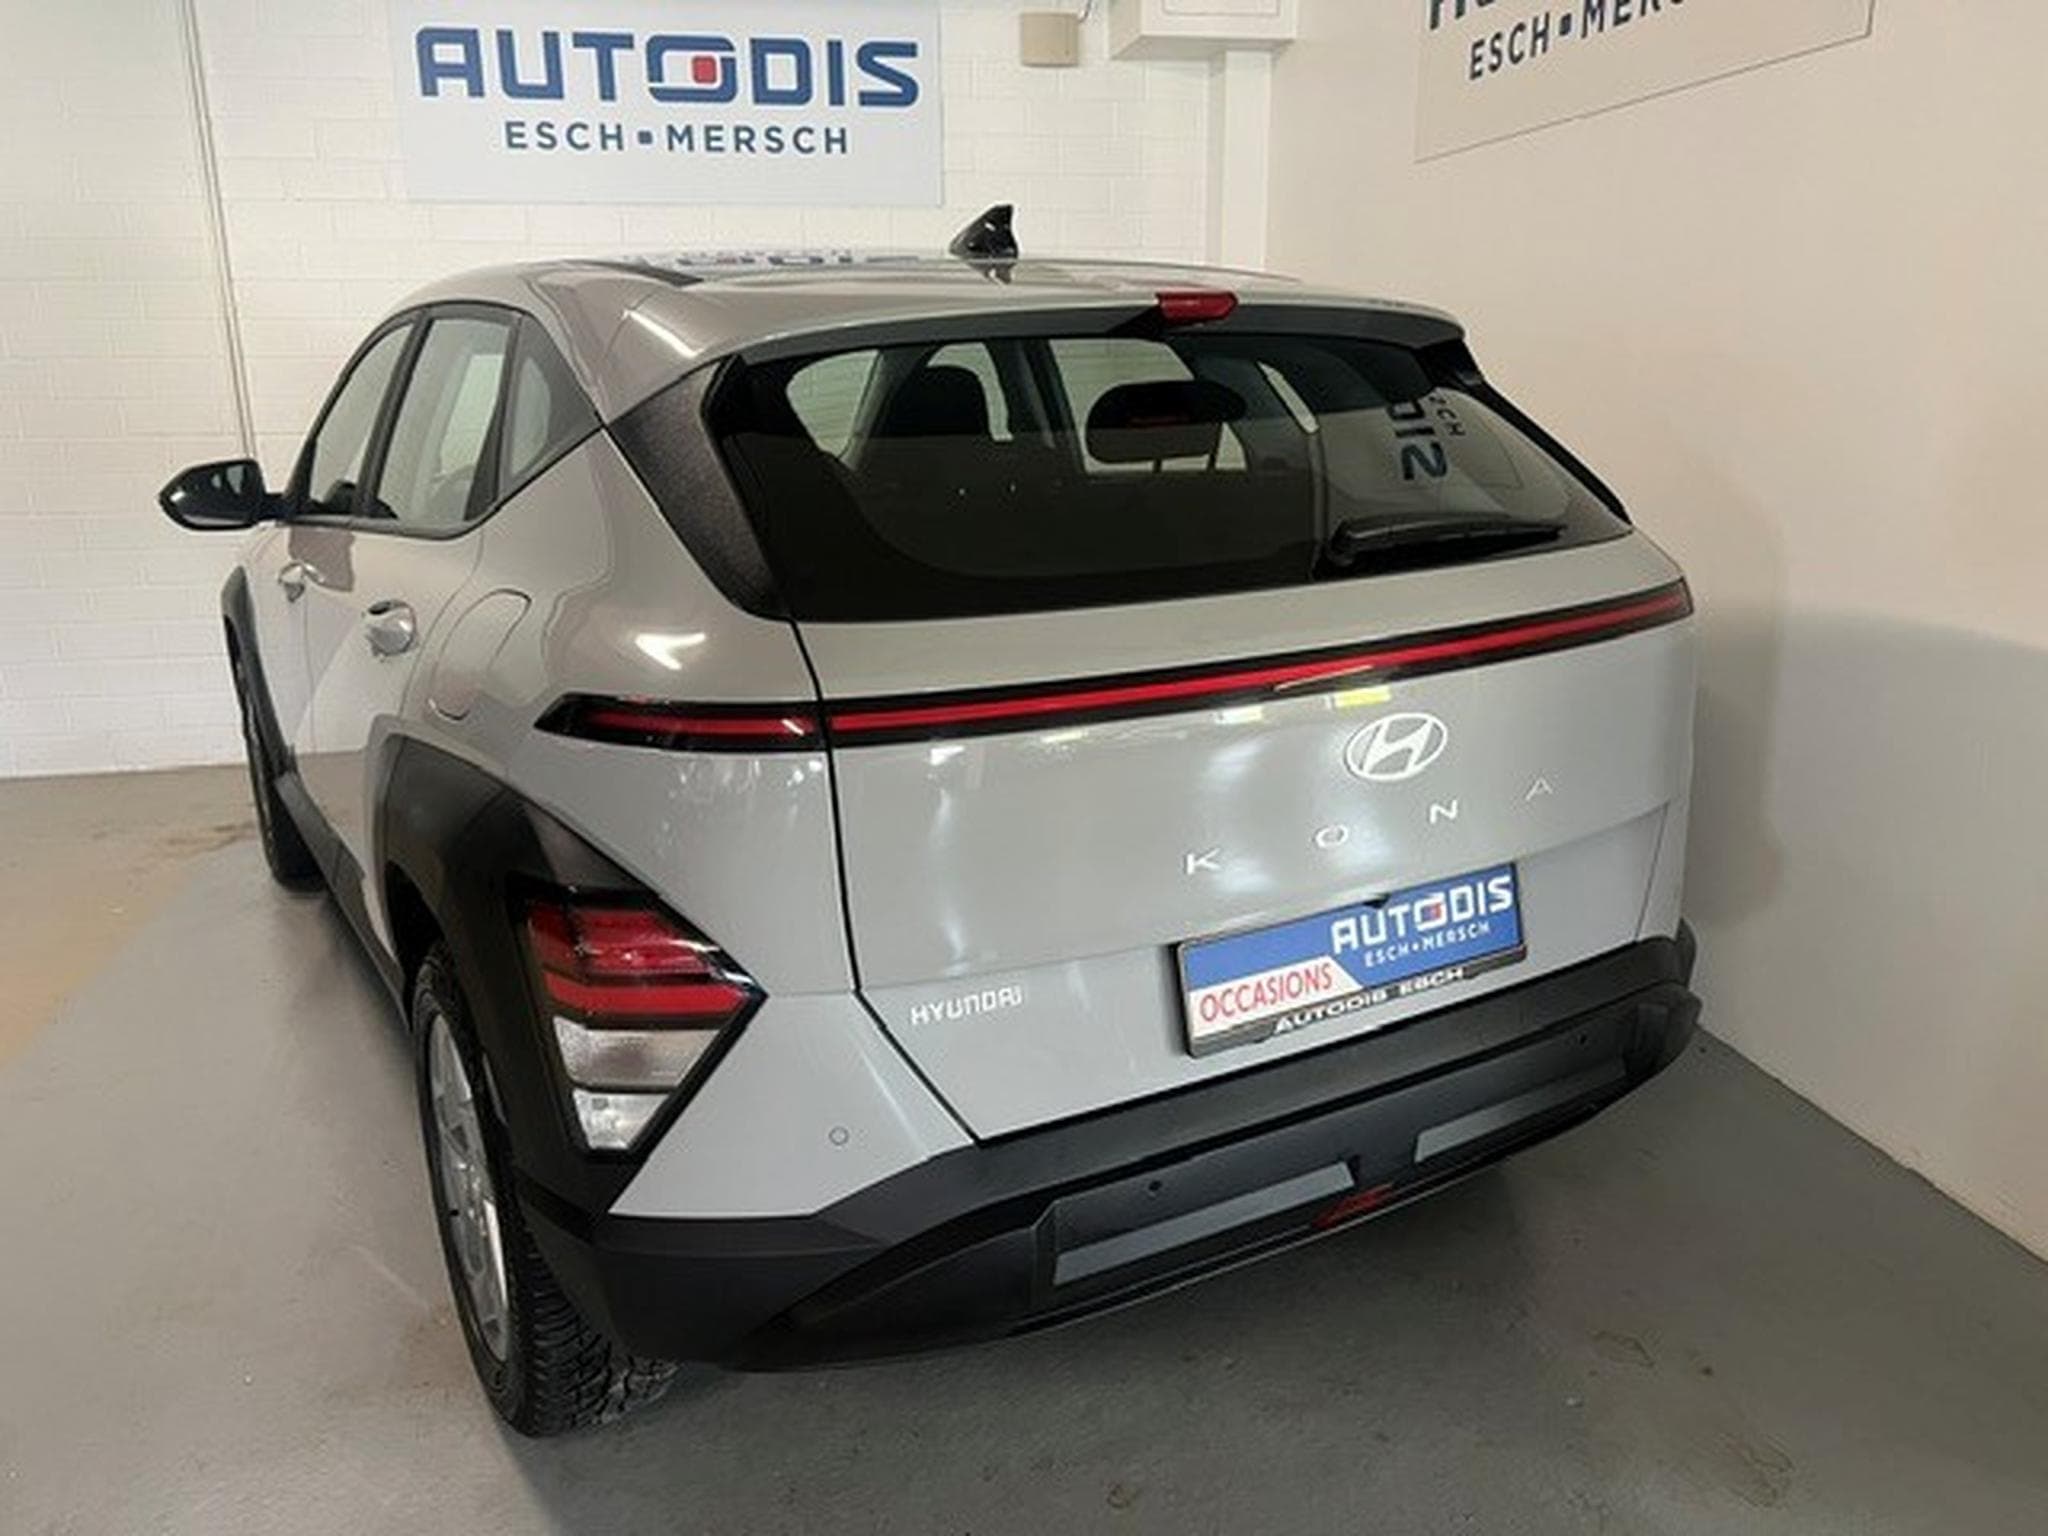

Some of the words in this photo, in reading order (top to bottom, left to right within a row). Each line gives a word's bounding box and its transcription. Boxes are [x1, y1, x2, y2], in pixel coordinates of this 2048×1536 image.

[416, 27, 918, 108] AUTODIS
[1469, 12, 1550, 80] ESCH
[506, 121, 624, 151] ESCH
[667, 124, 848, 155] MERSCH
[1186, 776, 1554, 877] KONA
[1331, 875, 1513, 954] AUTODIS
[1364, 943, 1409, 968] ESCH
[1421, 920, 1490, 951] MERSCH
[910, 985, 1023, 1026] HYUNDAI
[1199, 961, 1334, 1023] OCCASIONS
[1272, 989, 1388, 1035] AUTODIS
